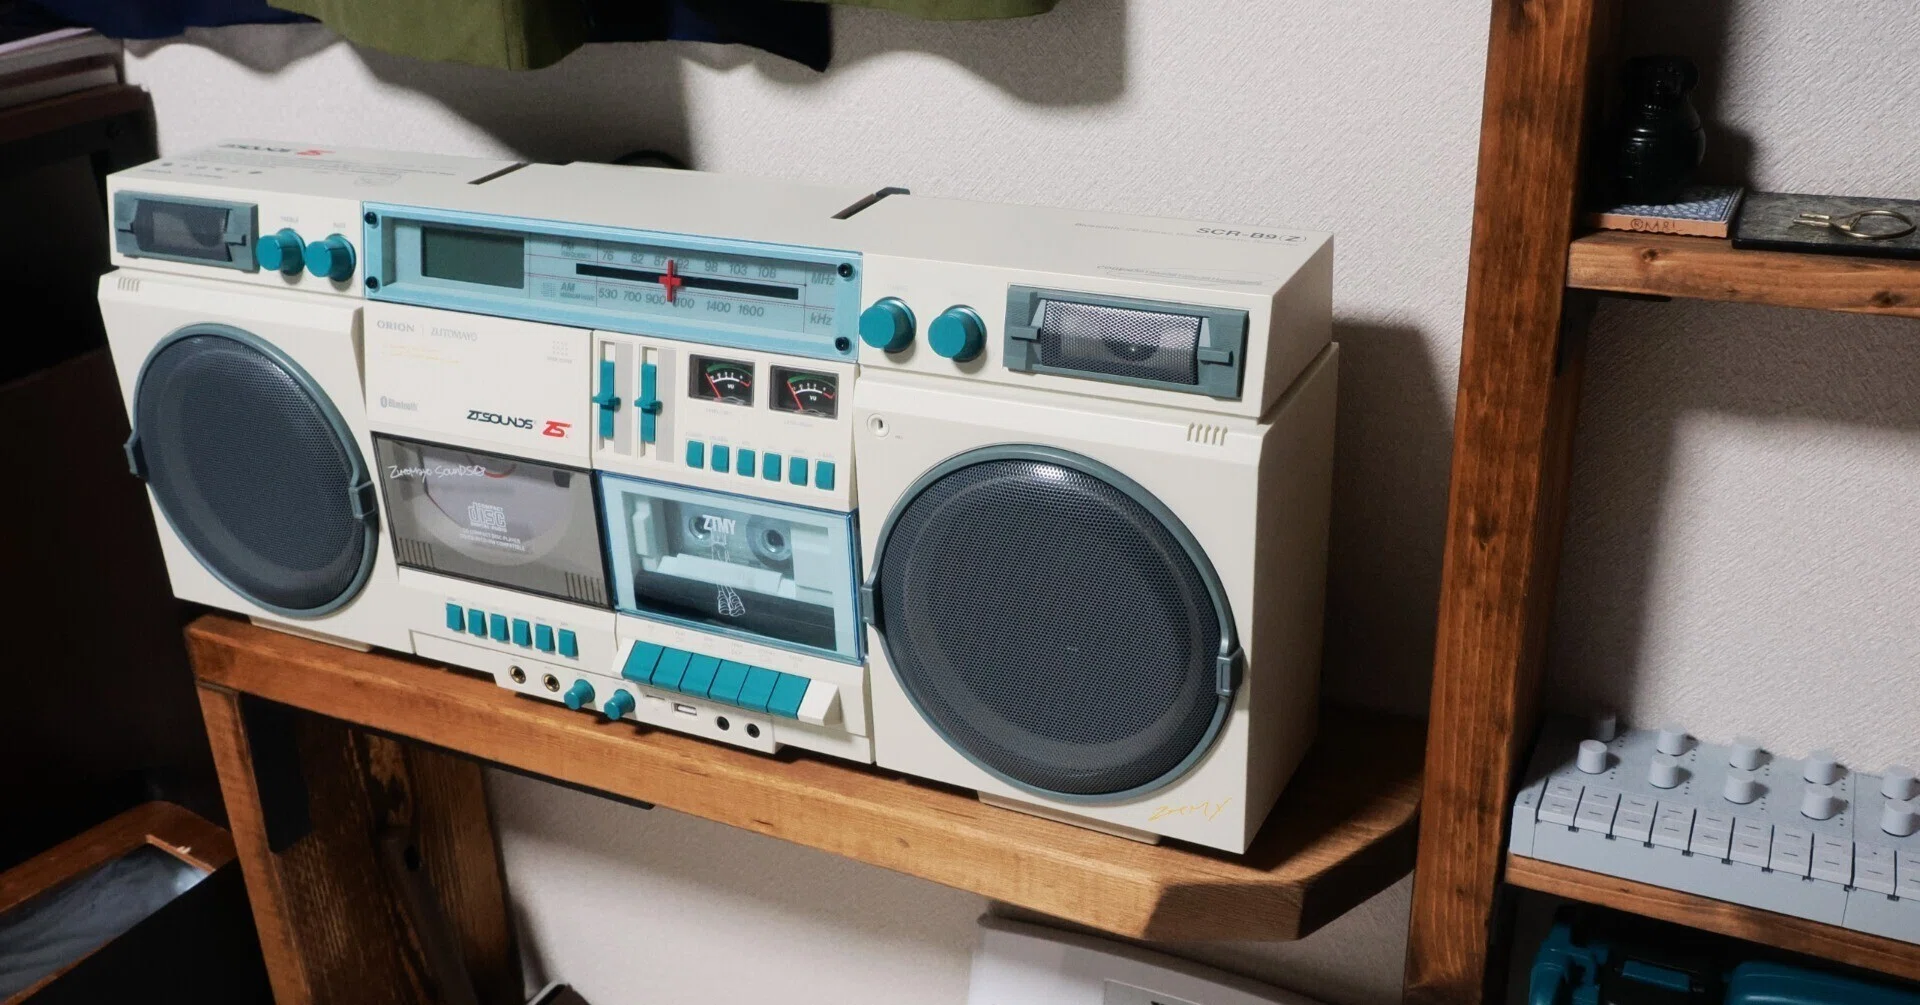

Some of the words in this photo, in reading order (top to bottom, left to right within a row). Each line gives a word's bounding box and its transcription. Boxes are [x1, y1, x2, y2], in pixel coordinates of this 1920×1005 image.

[602, 250, 614, 261] 76
[631, 253, 644, 265] 82
[704, 260, 718, 273] 98
[729, 263, 748, 276] 103
[757, 266, 777, 279] 108
[811, 271, 836, 286] MHz
[560, 281, 576, 292] AM
[599, 288, 618, 300] 530
[624, 290, 642, 303] 700
[645, 293, 667, 305] 900
[706, 300, 732, 314] 1400
[738, 304, 765, 318] 1600
[810, 311, 833, 326] kHz
[376, 319, 415, 333] ORION
[702, 514, 736, 535] ZTMY
